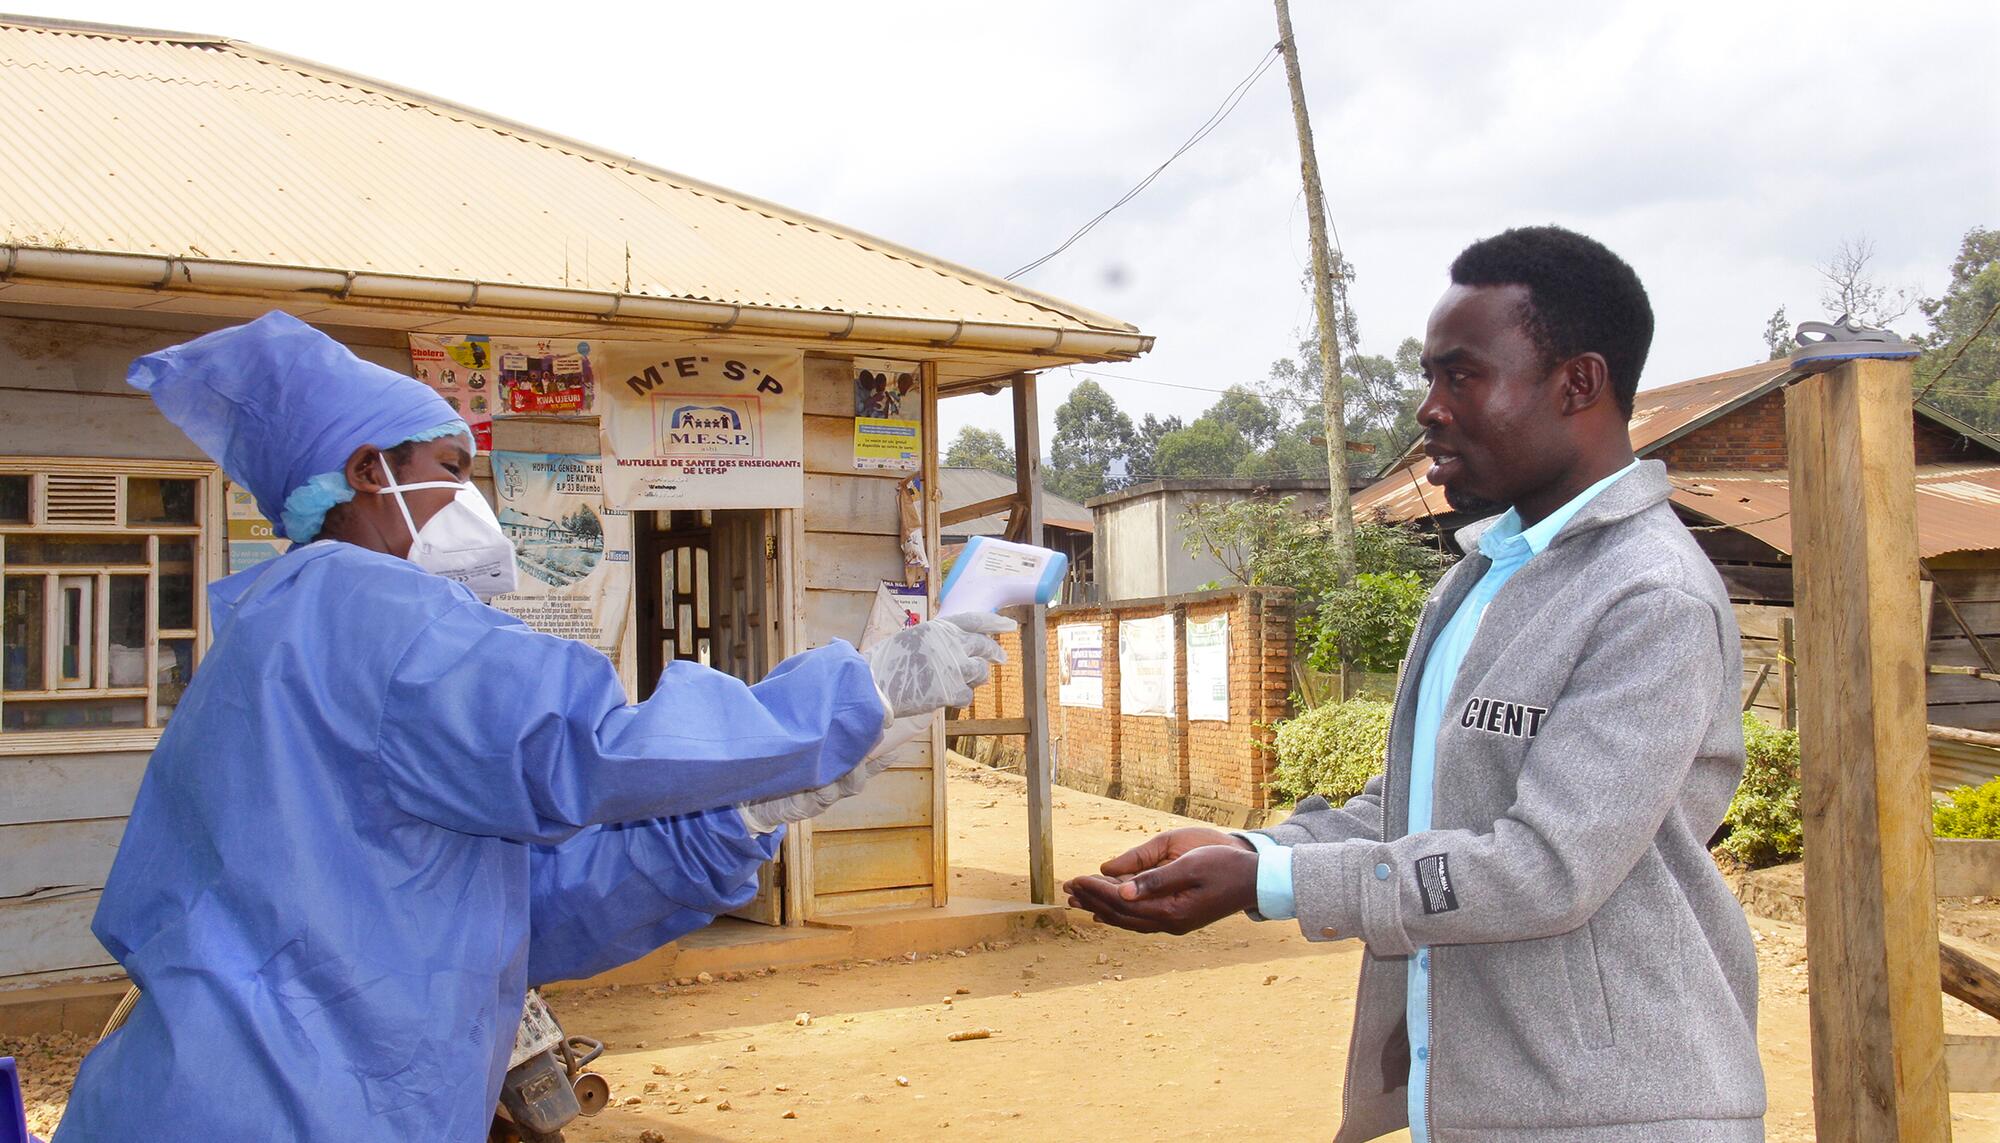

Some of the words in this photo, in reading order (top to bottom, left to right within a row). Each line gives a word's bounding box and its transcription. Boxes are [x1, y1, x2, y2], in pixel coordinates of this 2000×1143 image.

[411, 348, 445, 357] Cholera
[536, 396, 554, 405] KWA
[670, 433, 750, 446] M.E.S.P.
[586, 465, 594, 473] DE
[698, 467, 728, 475] L'EPSP
[566, 474, 574, 482] DE
[575, 474, 596, 483] KATWA
[567, 483, 575, 491] 33
[575, 484, 601, 493] Butembo
[1460, 697, 1547, 738] CIENT
